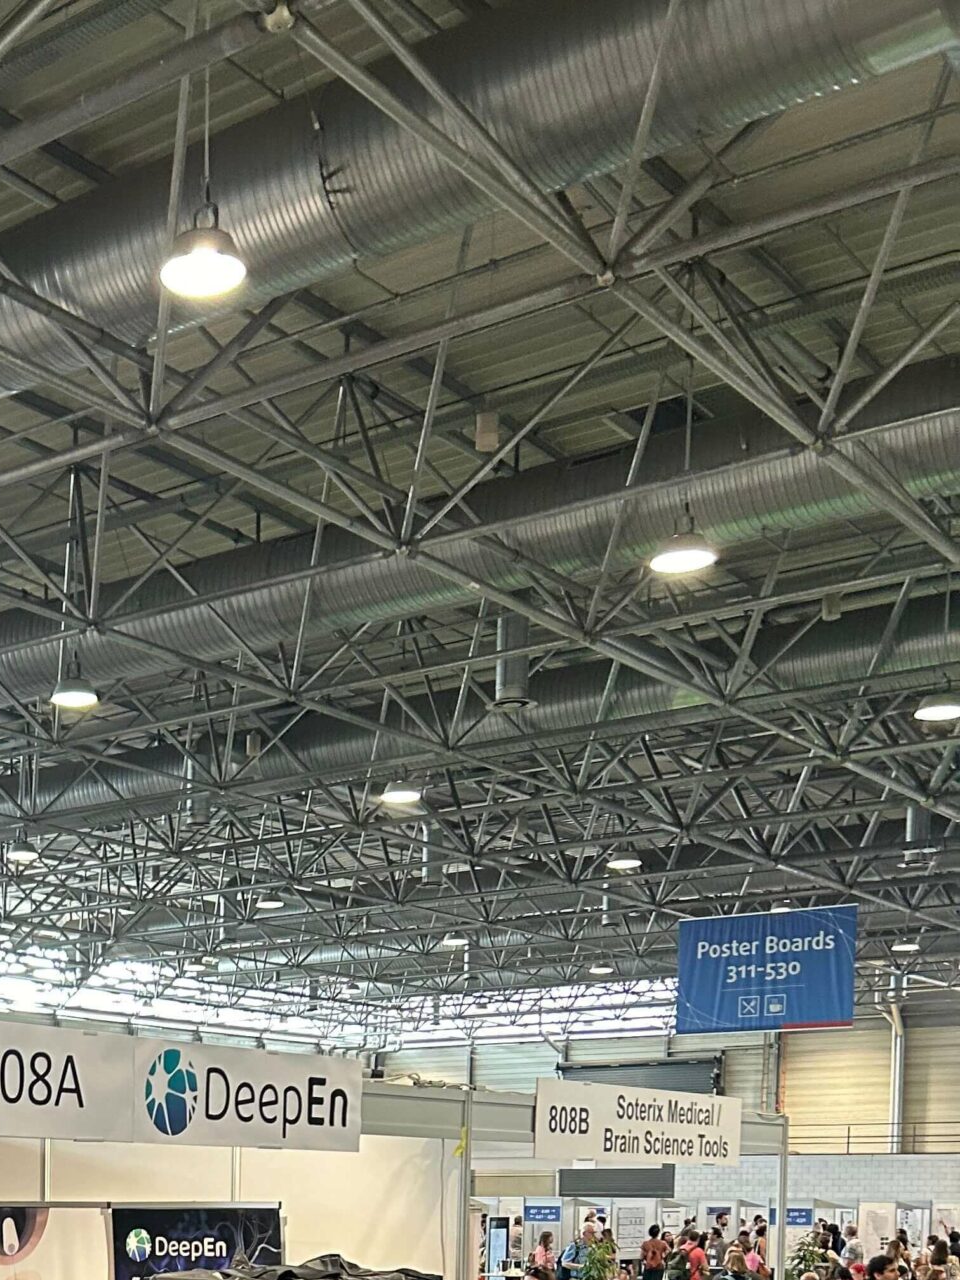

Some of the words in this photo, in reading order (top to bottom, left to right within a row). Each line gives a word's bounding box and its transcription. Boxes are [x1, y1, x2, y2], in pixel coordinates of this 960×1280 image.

[696, 940, 759, 960] Poster
[764, 930, 836, 954] Boards
[726, 960, 801, 983] 311-530
[204, 1066, 349, 1139] DeepEn
[616, 1094, 664, 1123] Soterix
[667, 1099, 715, 1127] Medical
[716, 1103, 723, 1127] /
[548, 1105, 590, 1135] 808B
[603, 1127, 640, 1154] Brain
[643, 1130, 694, 1156] Science
[697, 1134, 729, 1159] Tools
[155, 1236, 227, 1262] DeepEn
